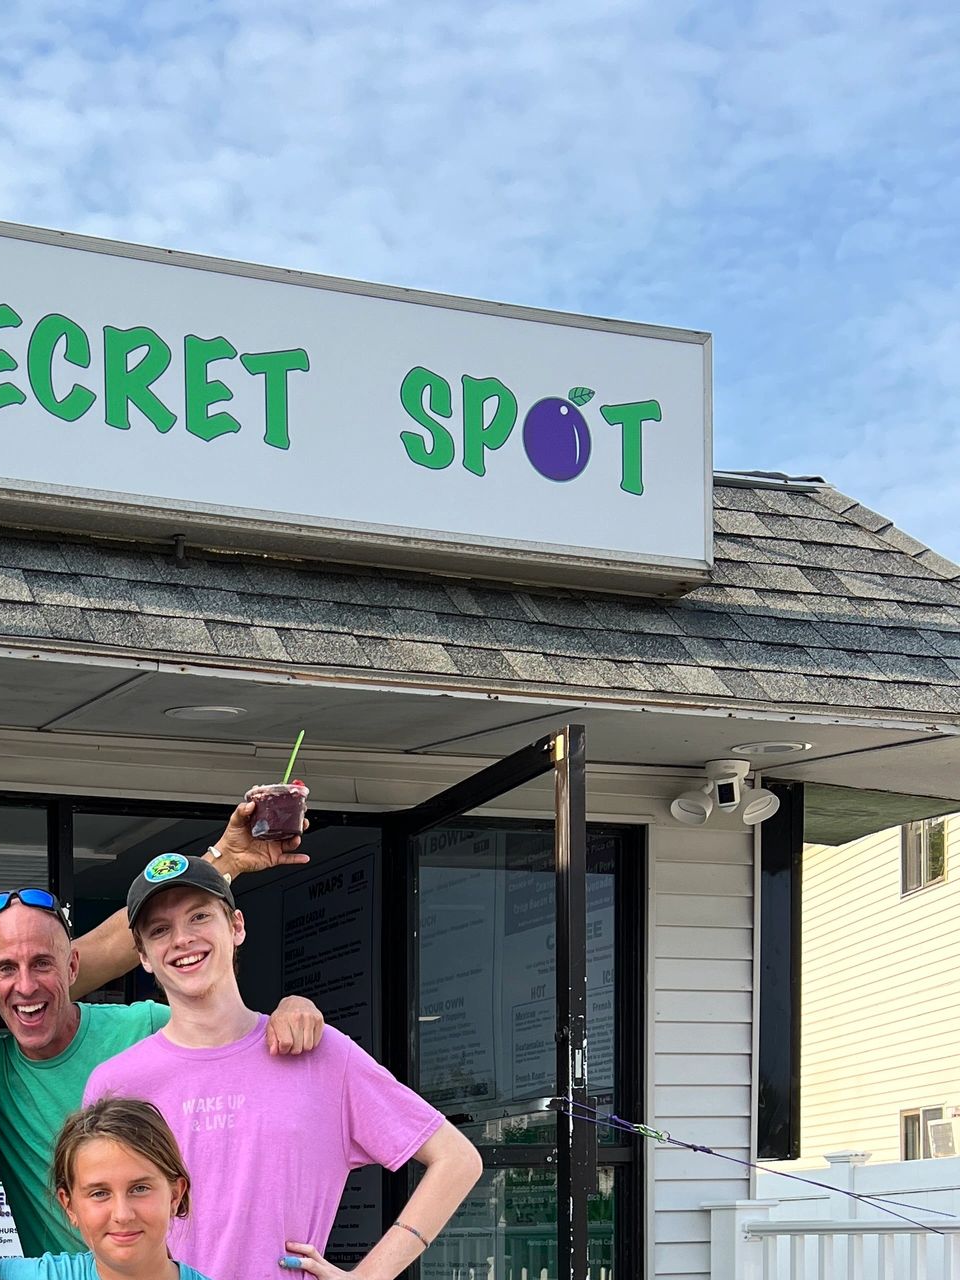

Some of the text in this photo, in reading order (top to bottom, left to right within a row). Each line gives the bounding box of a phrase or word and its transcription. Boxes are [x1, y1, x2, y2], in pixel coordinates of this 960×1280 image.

[308, 873, 344, 901] WRAPS
[530, 984, 547, 1000] HOT
[424, 996, 465, 1015] YOUR OWN
[182, 1094, 246, 1116] WAKE UP
[192, 1114, 235, 1131] & LIVE
